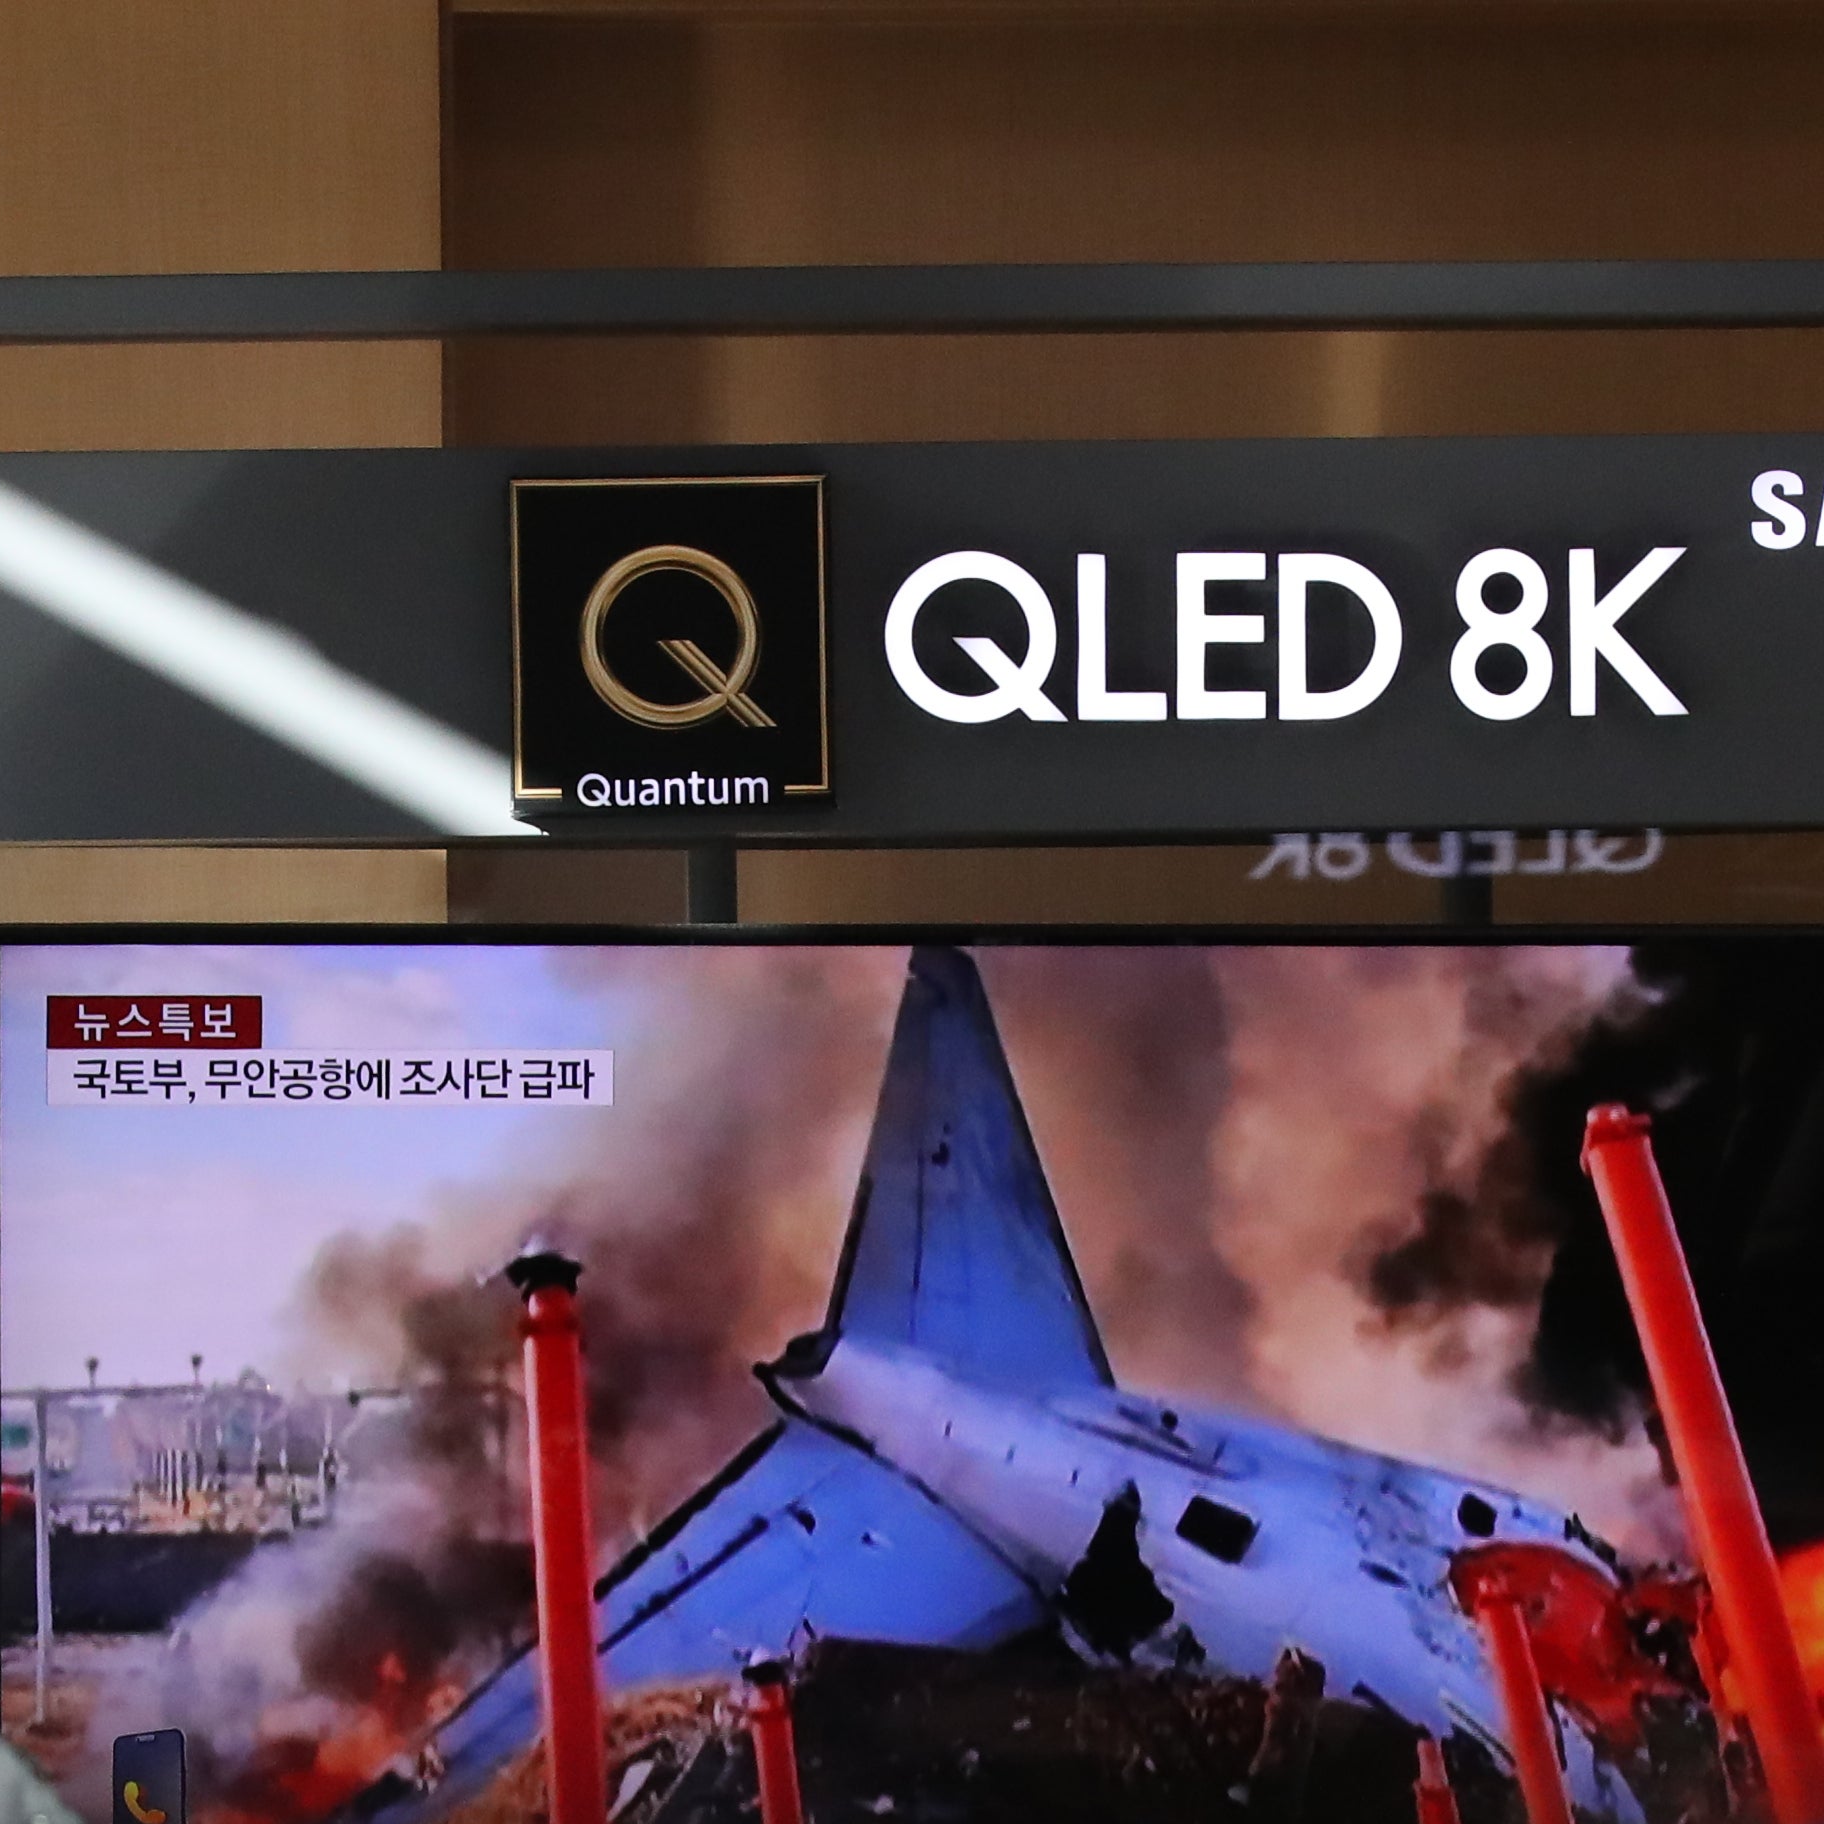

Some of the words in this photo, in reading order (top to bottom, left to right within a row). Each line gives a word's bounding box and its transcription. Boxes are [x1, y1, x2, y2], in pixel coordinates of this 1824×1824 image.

[884, 550, 1403, 724] QLED
[1450, 547, 1689, 721] 8K
[577, 771, 769, 807] Quantum
[74, 1003, 236, 1042] 뉴스특보
[73, 1059, 196, 1104] 국토부,
[204, 1058, 391, 1100] 무안공항에
[399, 1058, 513, 1100] 조사단
[519, 1058, 595, 1100] 급파
